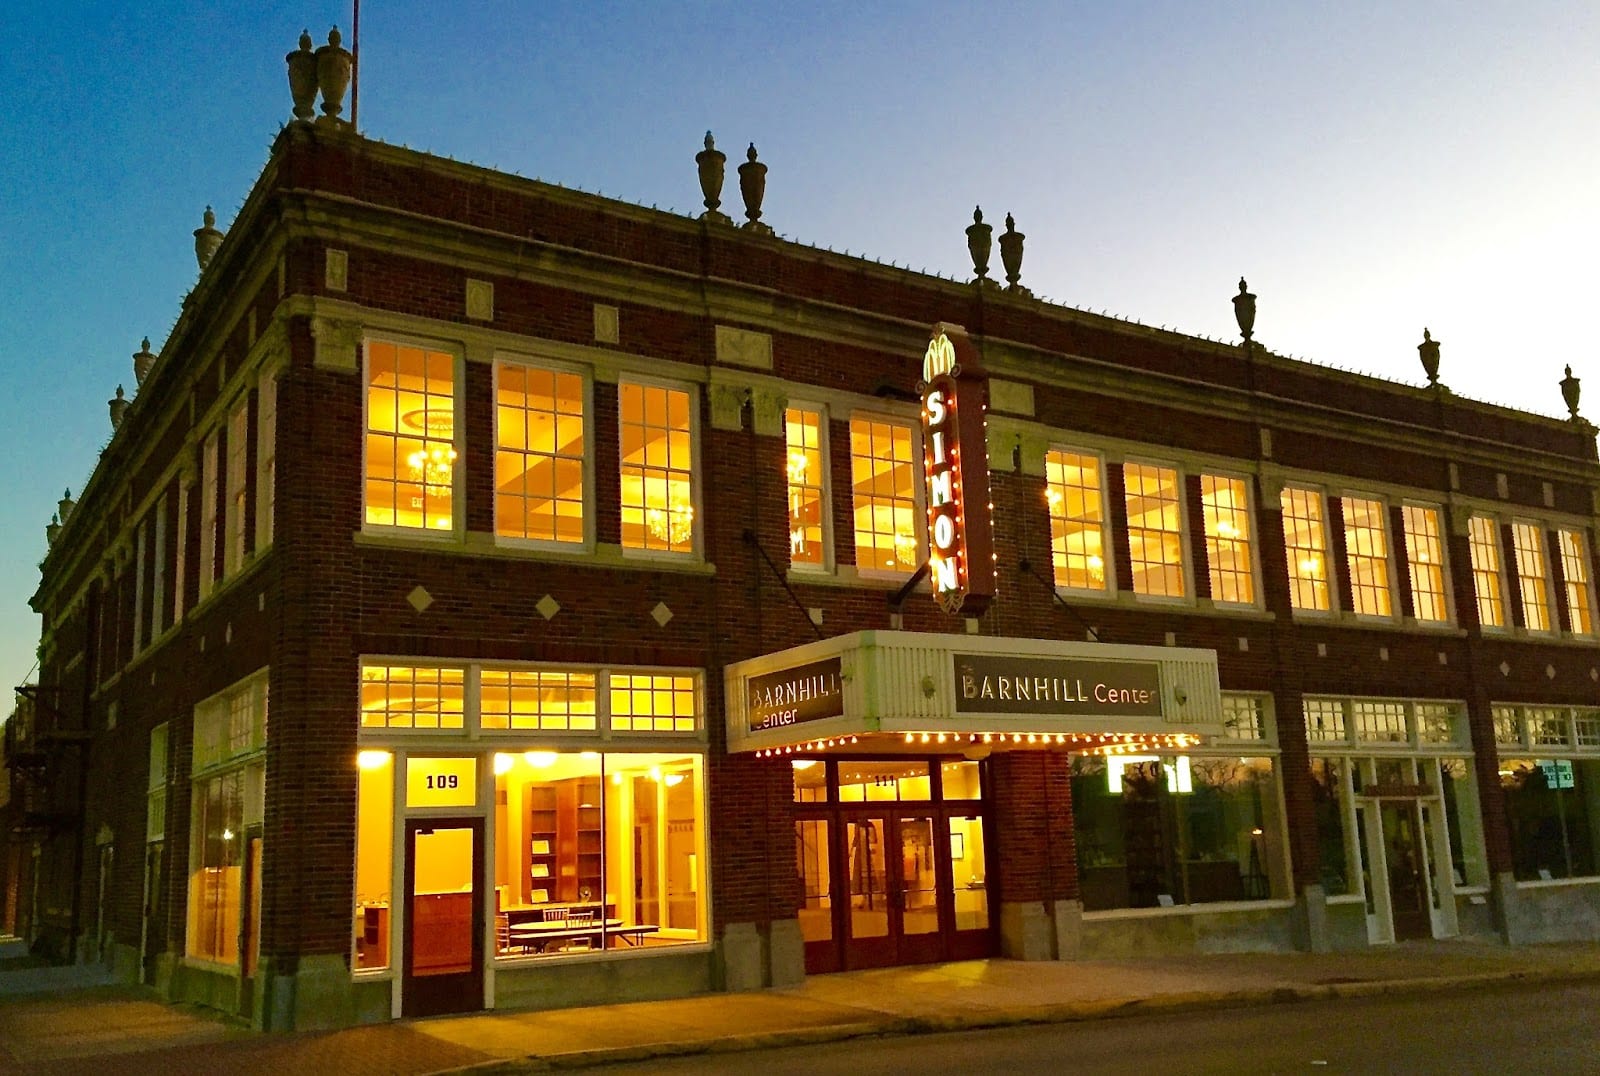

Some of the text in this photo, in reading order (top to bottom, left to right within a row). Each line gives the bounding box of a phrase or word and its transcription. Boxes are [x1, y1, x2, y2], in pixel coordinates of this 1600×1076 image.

[926, 390, 959, 593] SIMON
[753, 673, 840, 709] BARNHILL
[962, 674, 1157, 704] BARNHILL Center
[426, 775, 458, 789] 109
[874, 774, 895, 787] 111
